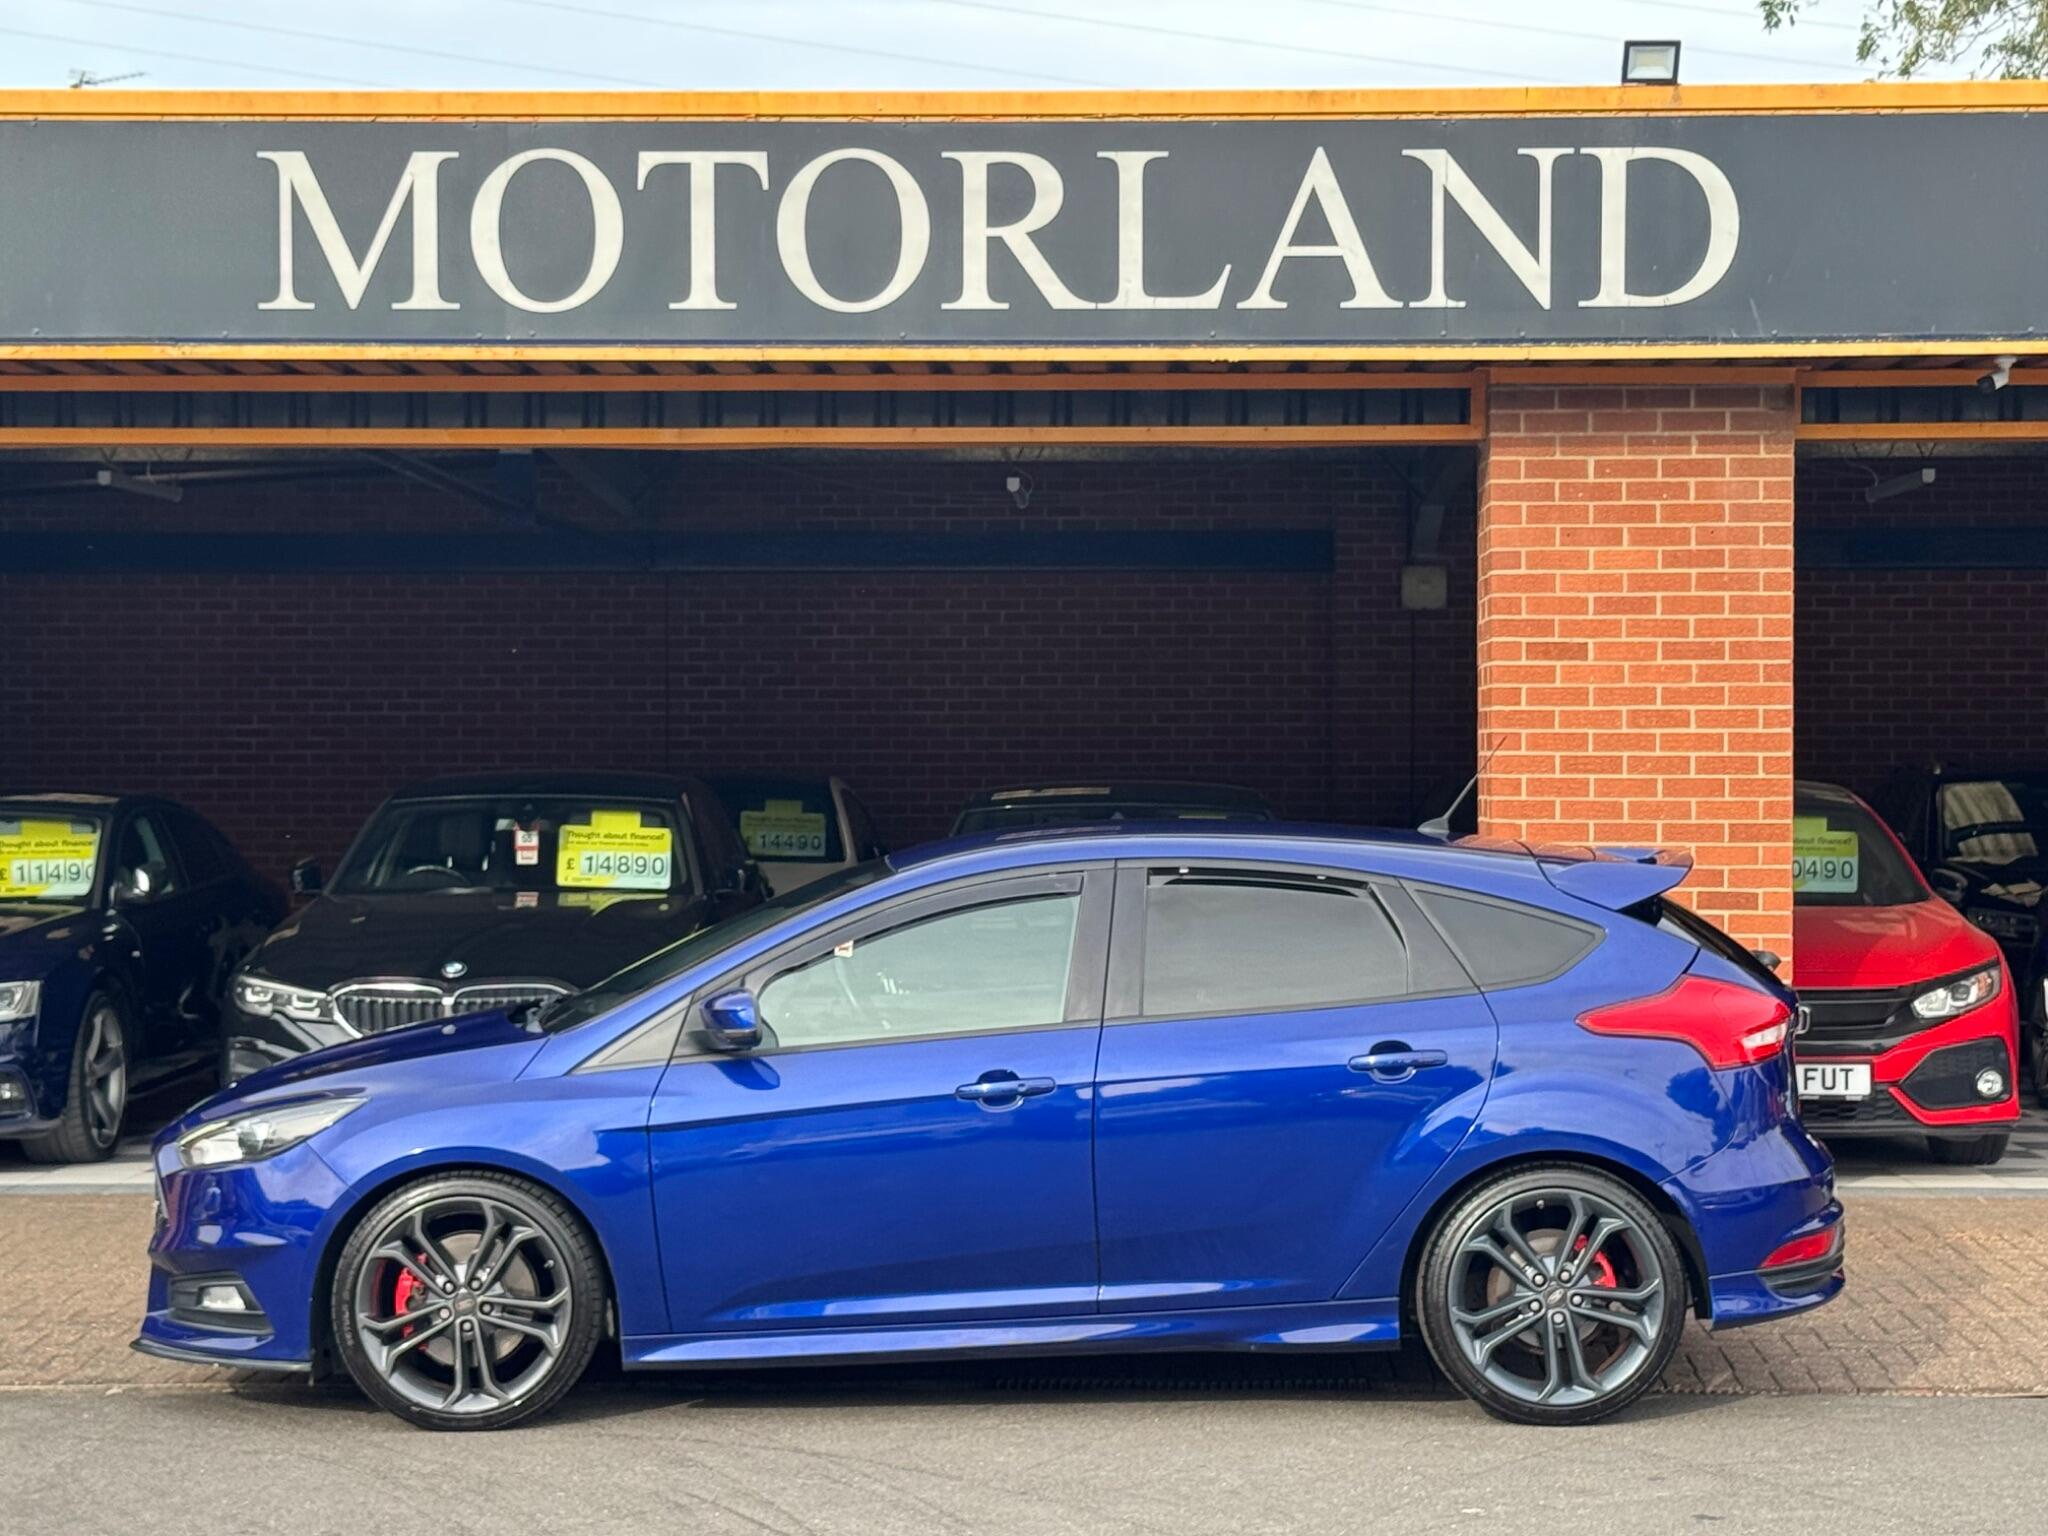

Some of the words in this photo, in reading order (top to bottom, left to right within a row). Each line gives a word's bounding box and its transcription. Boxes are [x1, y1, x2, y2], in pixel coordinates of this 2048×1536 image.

[256, 146, 1741, 314] MOTORLAND
[61, 839, 95, 847] finance
[568, 830, 601, 841] Thought
[603, 832, 628, 841] about
[630, 832, 665, 841] finance?
[584, 855, 665, 876] 14890
[1803, 1067, 1855, 1091] FUT
